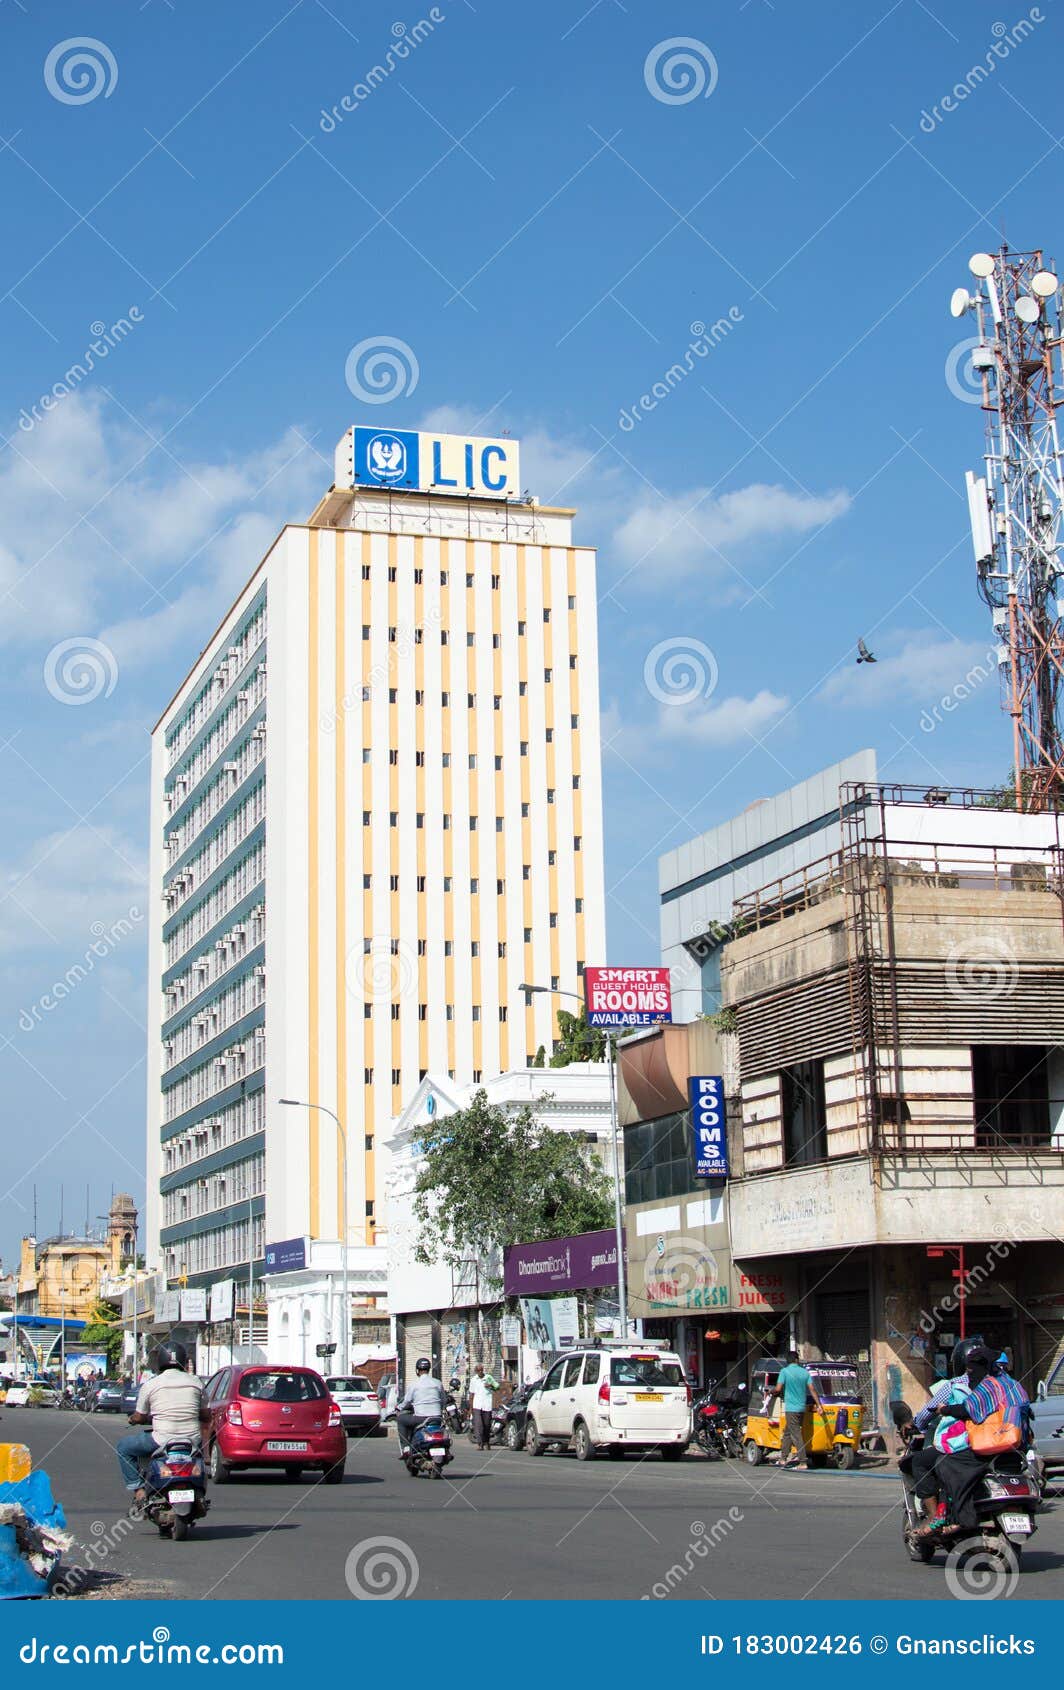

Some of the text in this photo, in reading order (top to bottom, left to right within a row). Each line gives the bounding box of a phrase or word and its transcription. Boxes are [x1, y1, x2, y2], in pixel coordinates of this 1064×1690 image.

[433, 441, 507, 491] LIC
[598, 970, 659, 982] SMART
[631, 983, 667, 991] HOUSE
[593, 991, 668, 1010] ROOMS
[592, 1014, 650, 1024] AVAILABLE
[699, 1079, 721, 1158] ROOMS
[697, 1160, 726, 1168] AVAILABLE
[740, 1274, 782, 1287] FRESH
[686, 1286, 727, 1309] FRESH
[738, 1292, 785, 1307] JUICES
